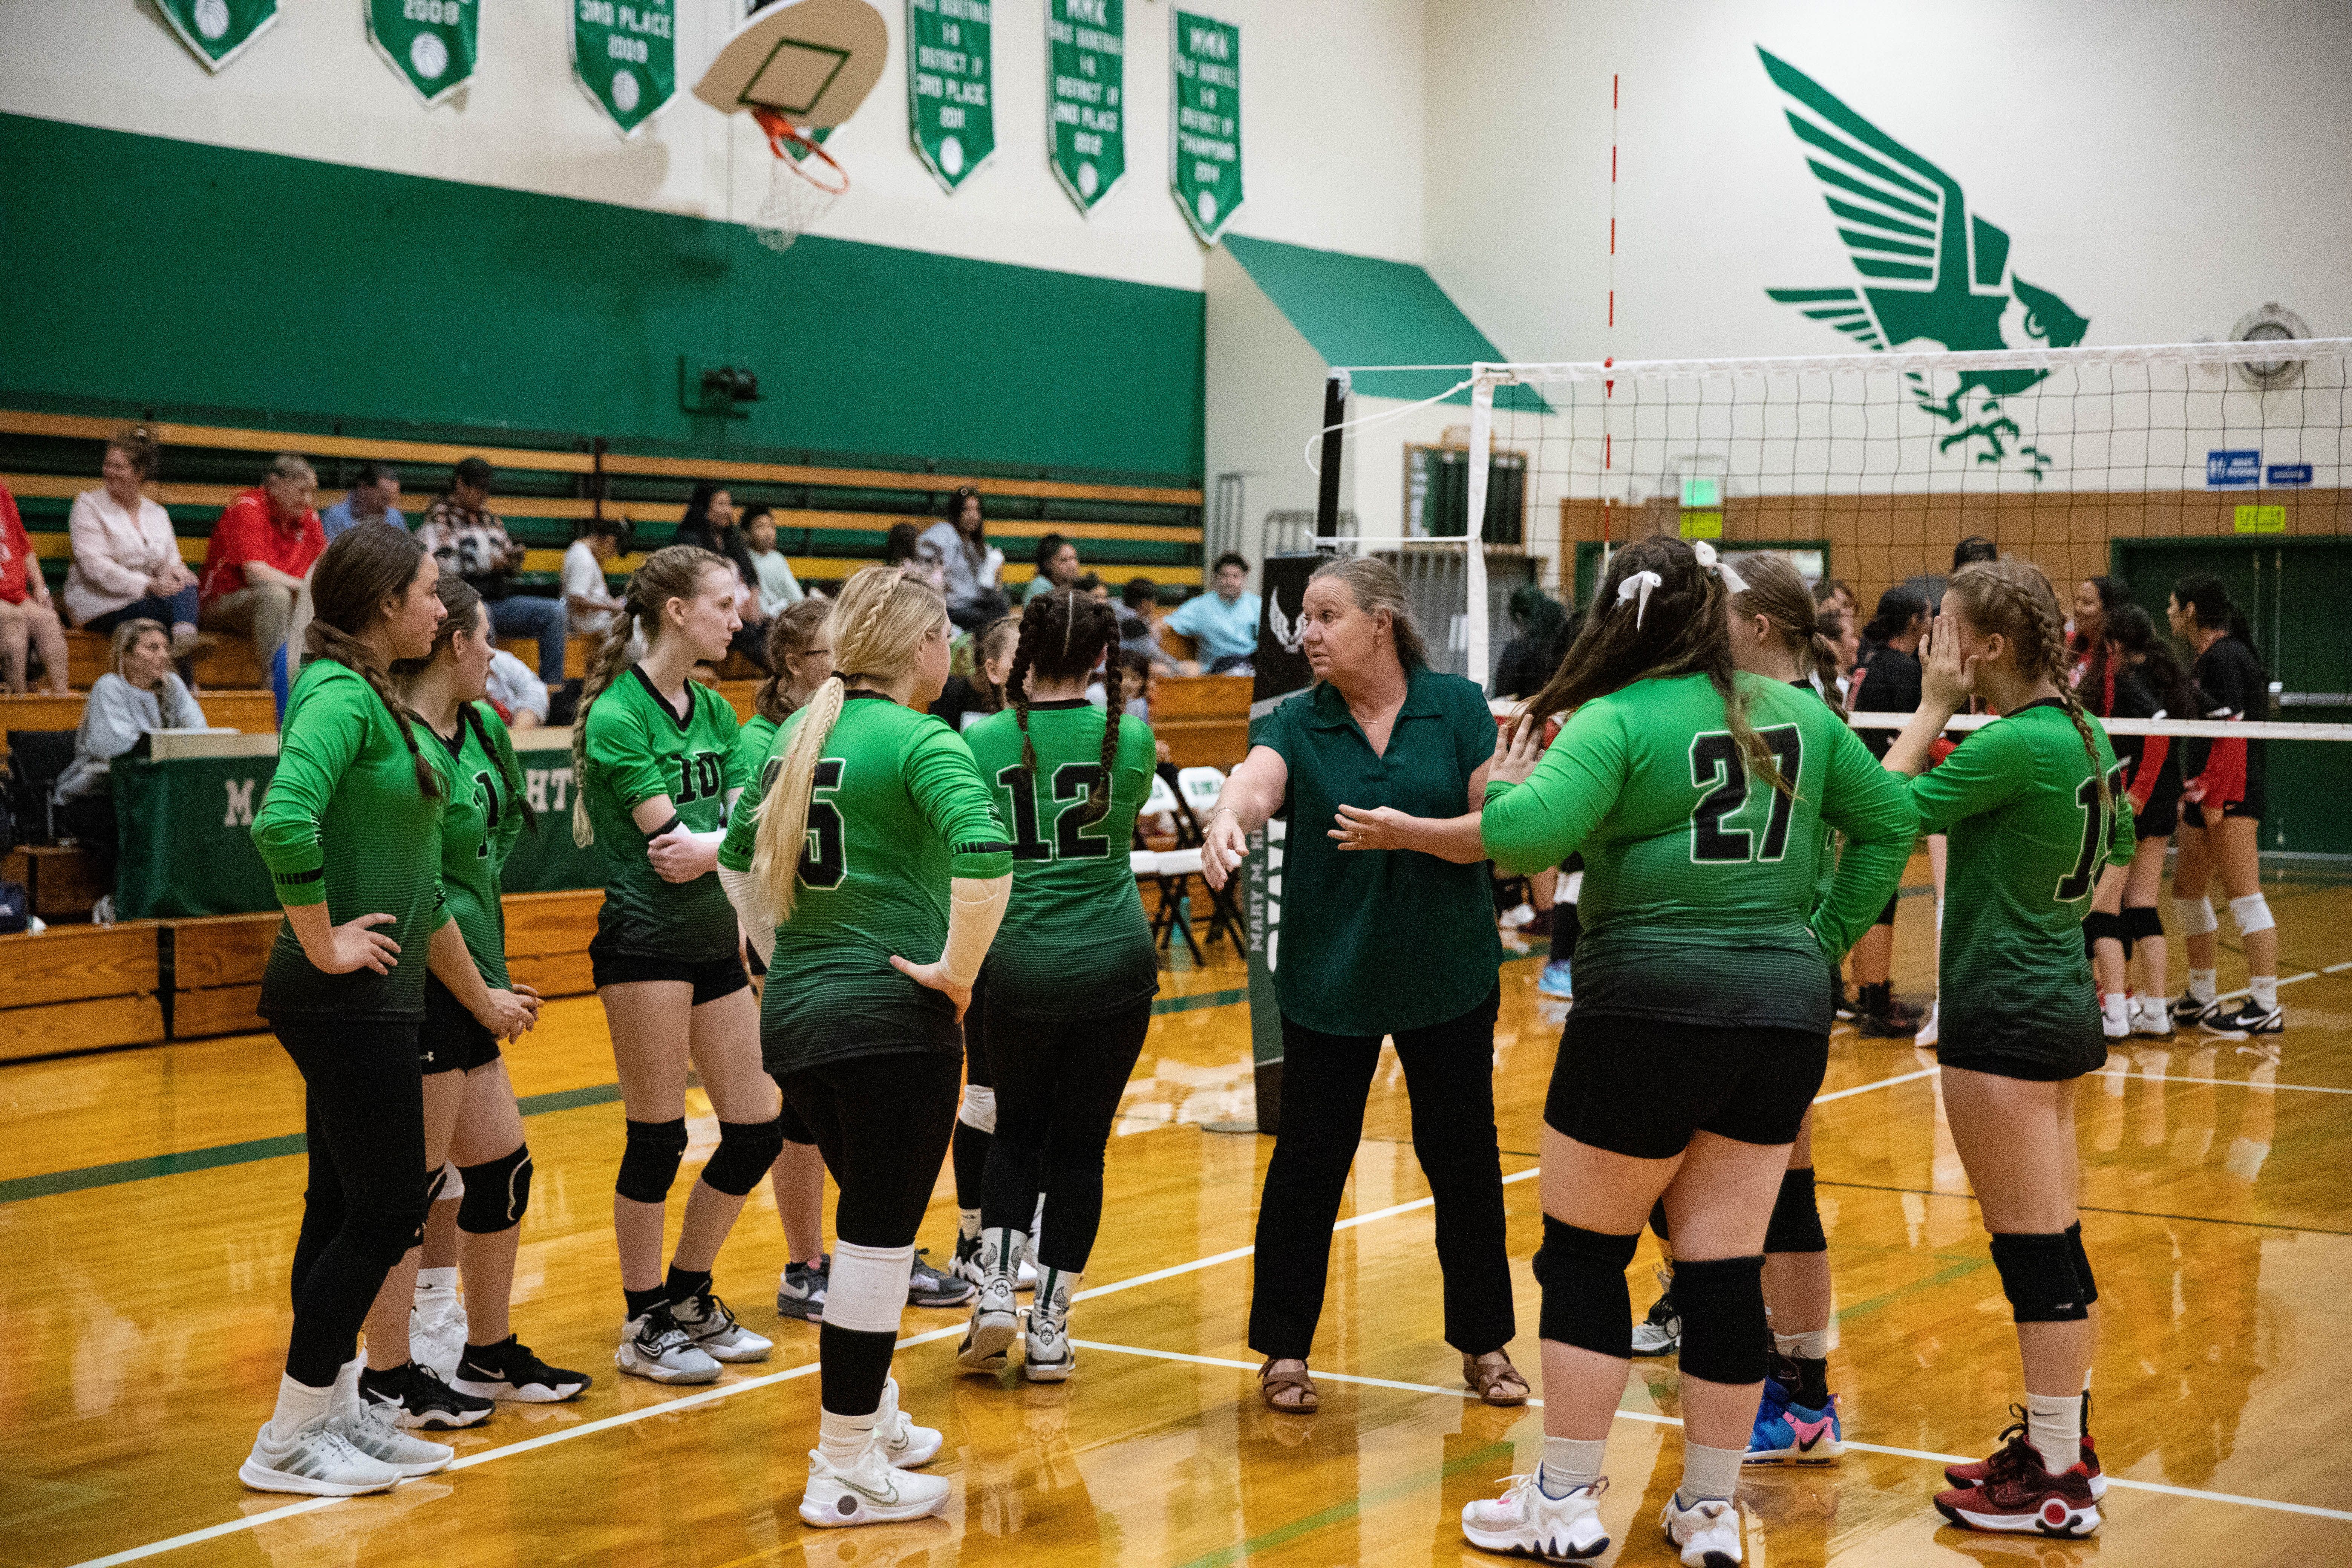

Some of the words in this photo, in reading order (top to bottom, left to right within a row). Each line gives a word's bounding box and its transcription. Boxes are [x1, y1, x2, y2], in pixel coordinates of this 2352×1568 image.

[619, 5, 671, 39] PLACE
[945, 78, 987, 106] PLACE
[1082, 106, 1118, 133] PLACE
[668, 750, 721, 806] 10
[1688, 723, 1803, 864] 27
[996, 762, 1113, 862] 12
[1250, 859, 1263, 882] M.
[1250, 889, 1263, 952] MARY
